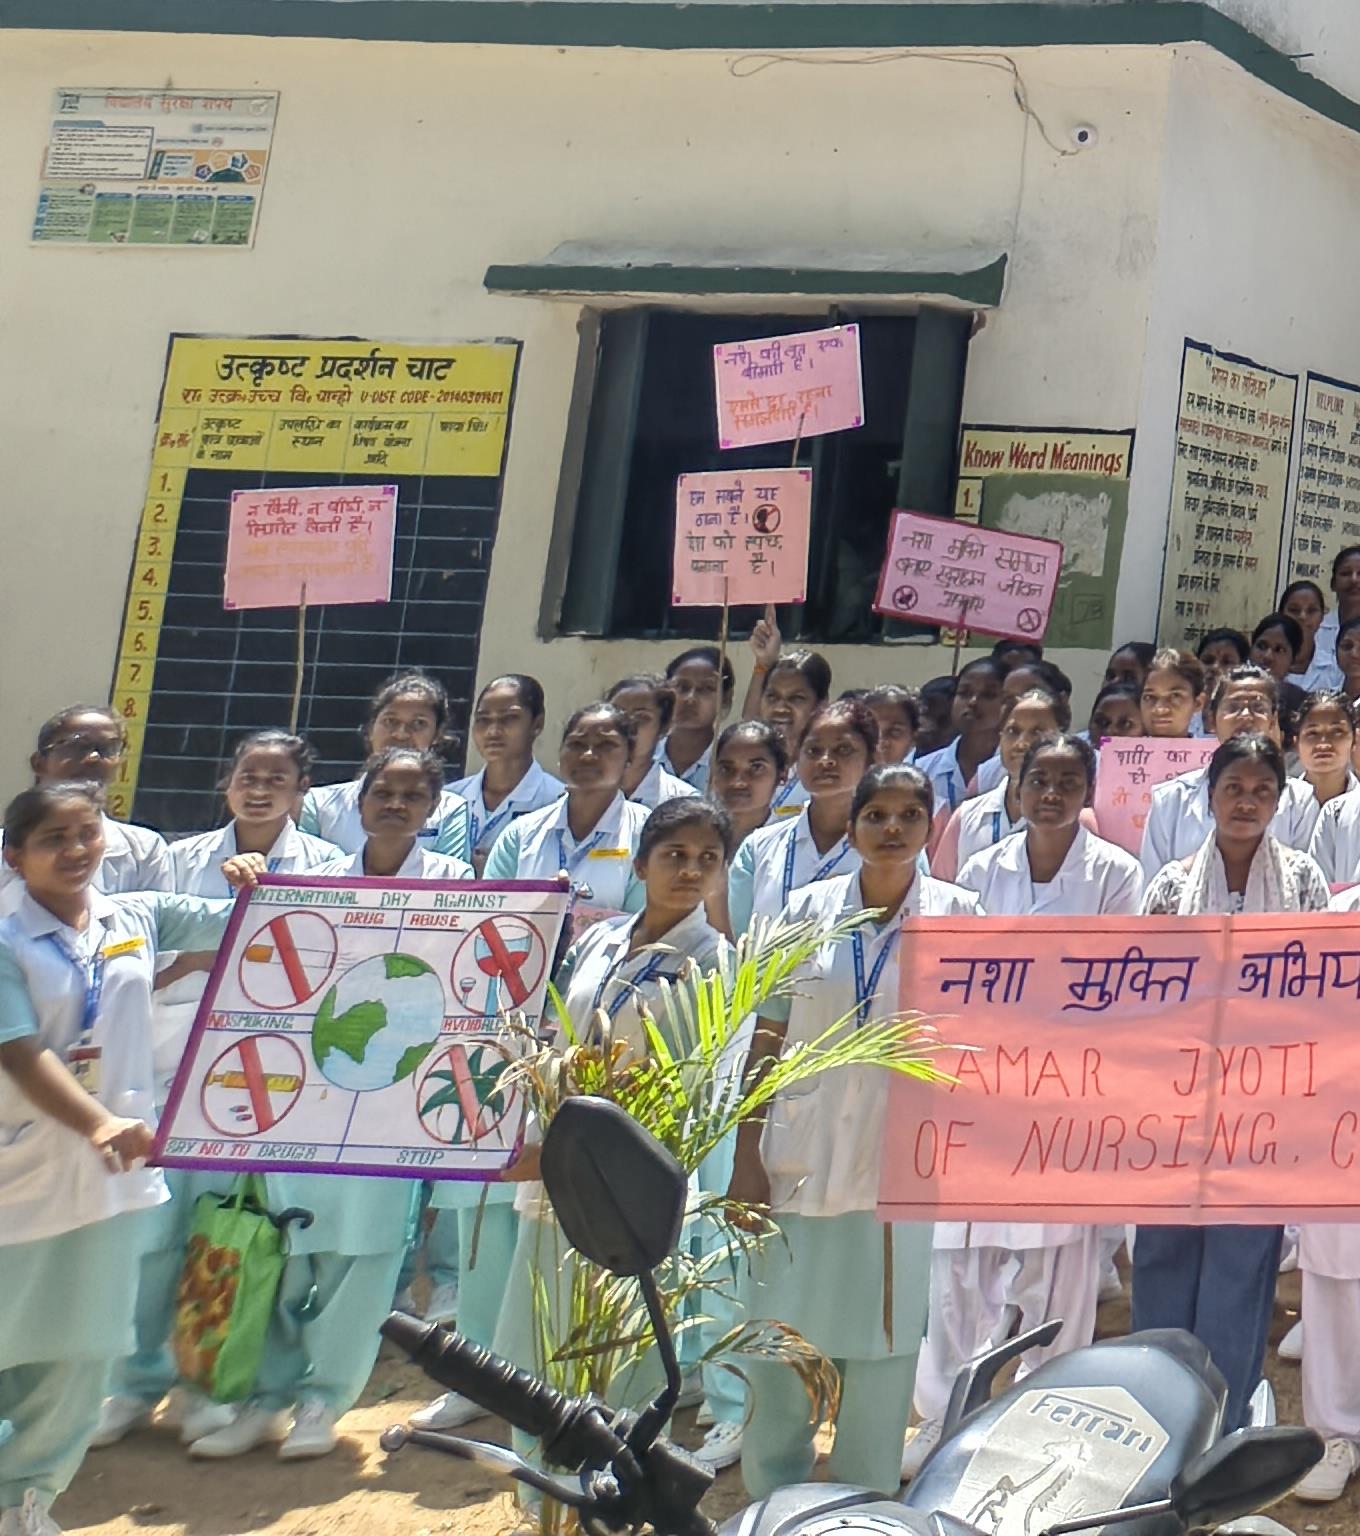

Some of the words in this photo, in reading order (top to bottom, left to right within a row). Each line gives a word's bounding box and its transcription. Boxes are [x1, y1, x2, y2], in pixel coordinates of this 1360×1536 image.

[216, 354, 310, 387] उत्कृष्ट
[315, 348, 397, 381] प्रदर्शन
[406, 357, 456, 381] चाट
[964, 440, 1004, 471] Know
[1009, 442, 1047, 472] Word
[1051, 439, 1124, 483] Meanings
[343, 911, 385, 926] DRUG
[410, 914, 460, 927] ABUSE
[380, 892, 412, 907] DAY
[433, 892, 508, 908] AGAINST
[939, 956, 1034, 1005] नशा
[1061, 945, 1200, 1012] मुक्ति
[949, 1044, 1107, 1099] AMAR
[1173, 1040, 1318, 1099] JYOTI
[397, 1150, 445, 1165] STOP
[913, 1119, 976, 1180] OF
[1030, 1393, 1156, 1454] Ferrari
